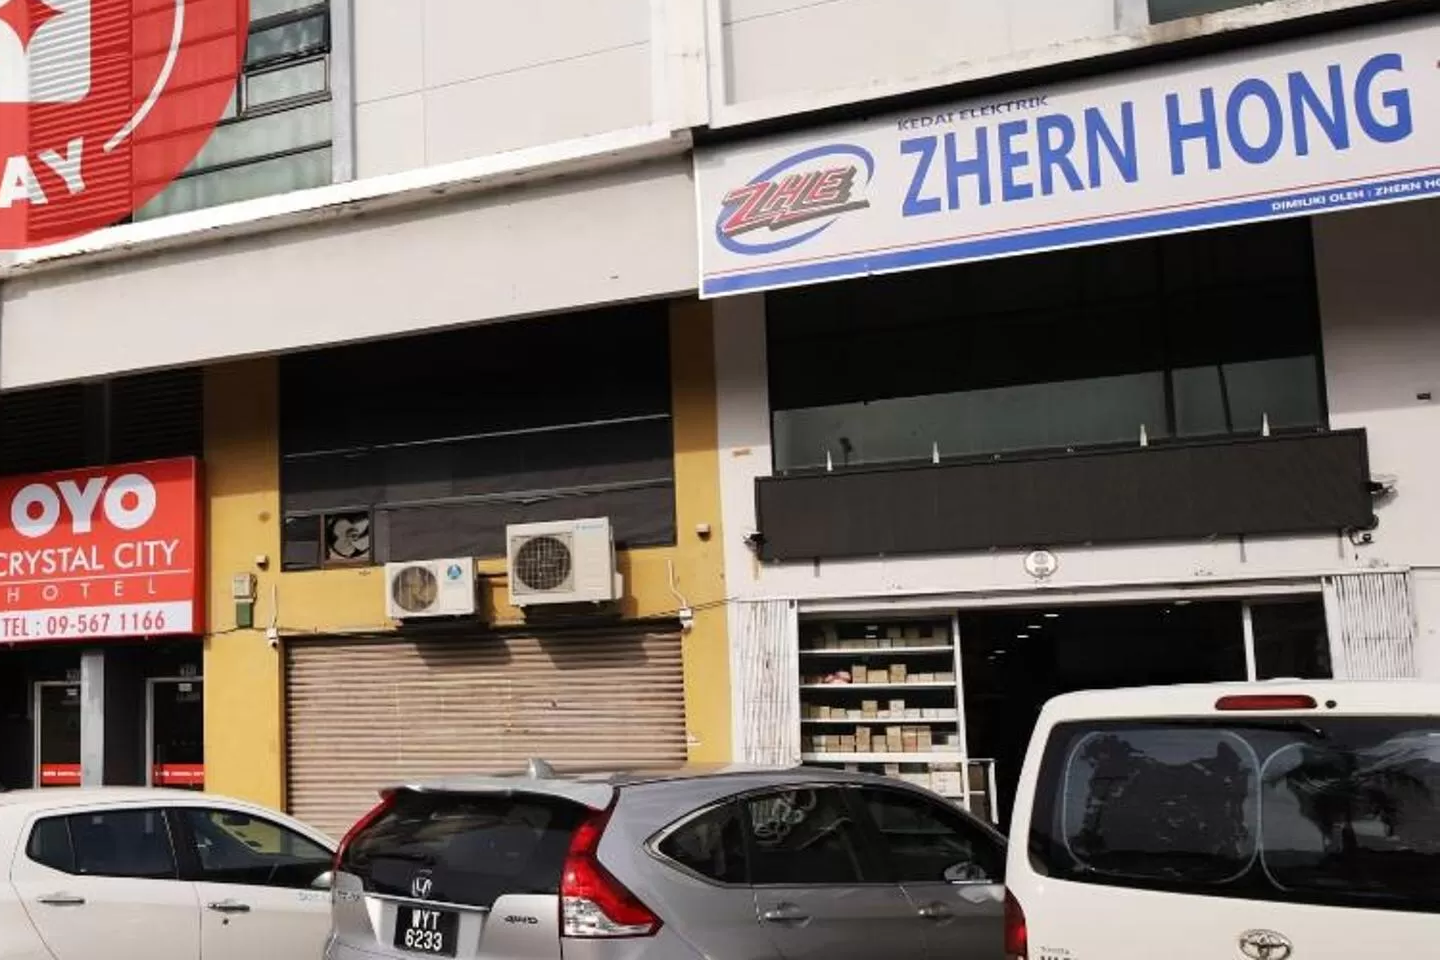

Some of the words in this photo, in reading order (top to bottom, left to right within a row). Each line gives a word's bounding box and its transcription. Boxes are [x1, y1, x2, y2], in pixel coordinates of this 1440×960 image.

[897, 114, 953, 131] KEDAI
[959, 96, 1049, 121] ELEKTRIK
[900, 101, 1138, 217] ZHERN
[1167, 53, 1413, 175] HONG
[721, 165, 858, 239] ZHE
[1329, 190, 1364, 204] OLEH
[1375, 182, 1422, 197] ZHERN
[11, 473, 157, 538] OYO
[114, 540, 180, 569] CITY
[7, 579, 156, 603] HOTEL
[47, 613, 111, 635] 09-567
[120, 610, 165, 631] 1166
[411, 909, 440, 930] WYT
[405, 929, 442, 951] 6233
